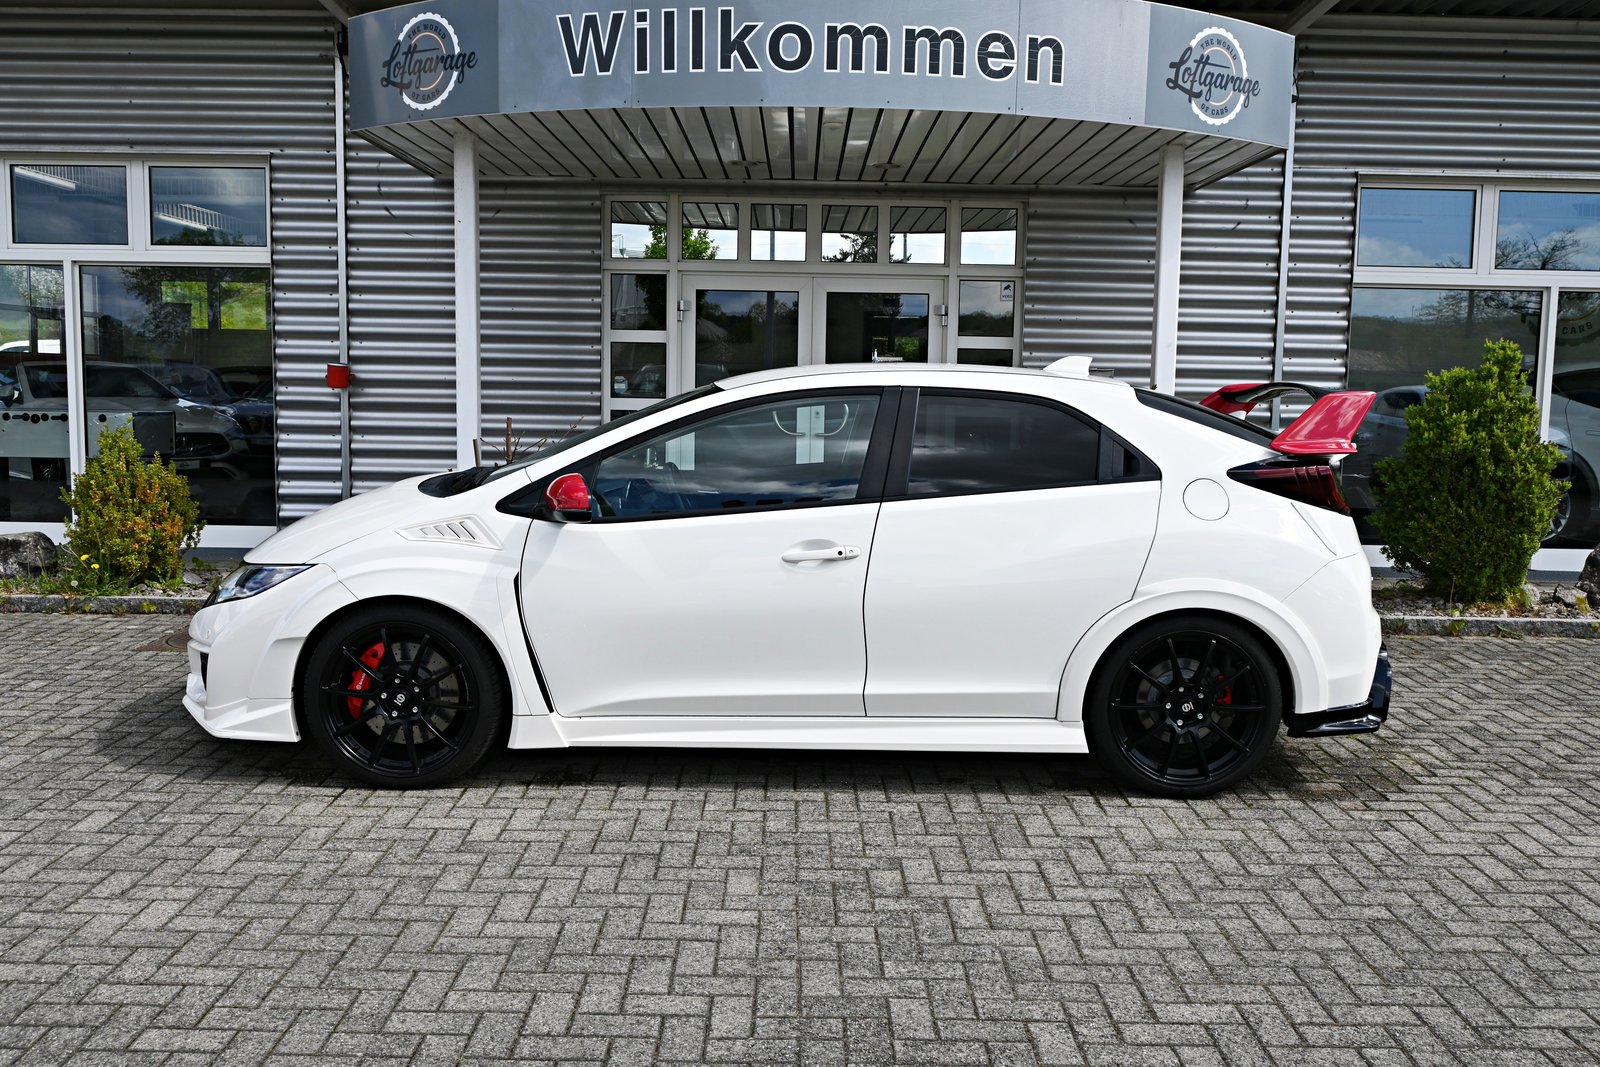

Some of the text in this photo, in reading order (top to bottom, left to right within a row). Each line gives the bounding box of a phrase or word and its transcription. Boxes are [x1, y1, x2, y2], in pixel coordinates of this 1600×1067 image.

[408, 23, 446, 40] THE WORLD
[556, 6, 1065, 87] Willkommen
[1200, 38, 1237, 61] THE WORLD
[381, 41, 478, 95] Loftgarage
[1166, 46, 1261, 109] Loftgarage
[412, 89, 440, 101] OF CARS
[1200, 103, 1229, 116] OF CARS
[1562, 321, 1593, 334] CARS
